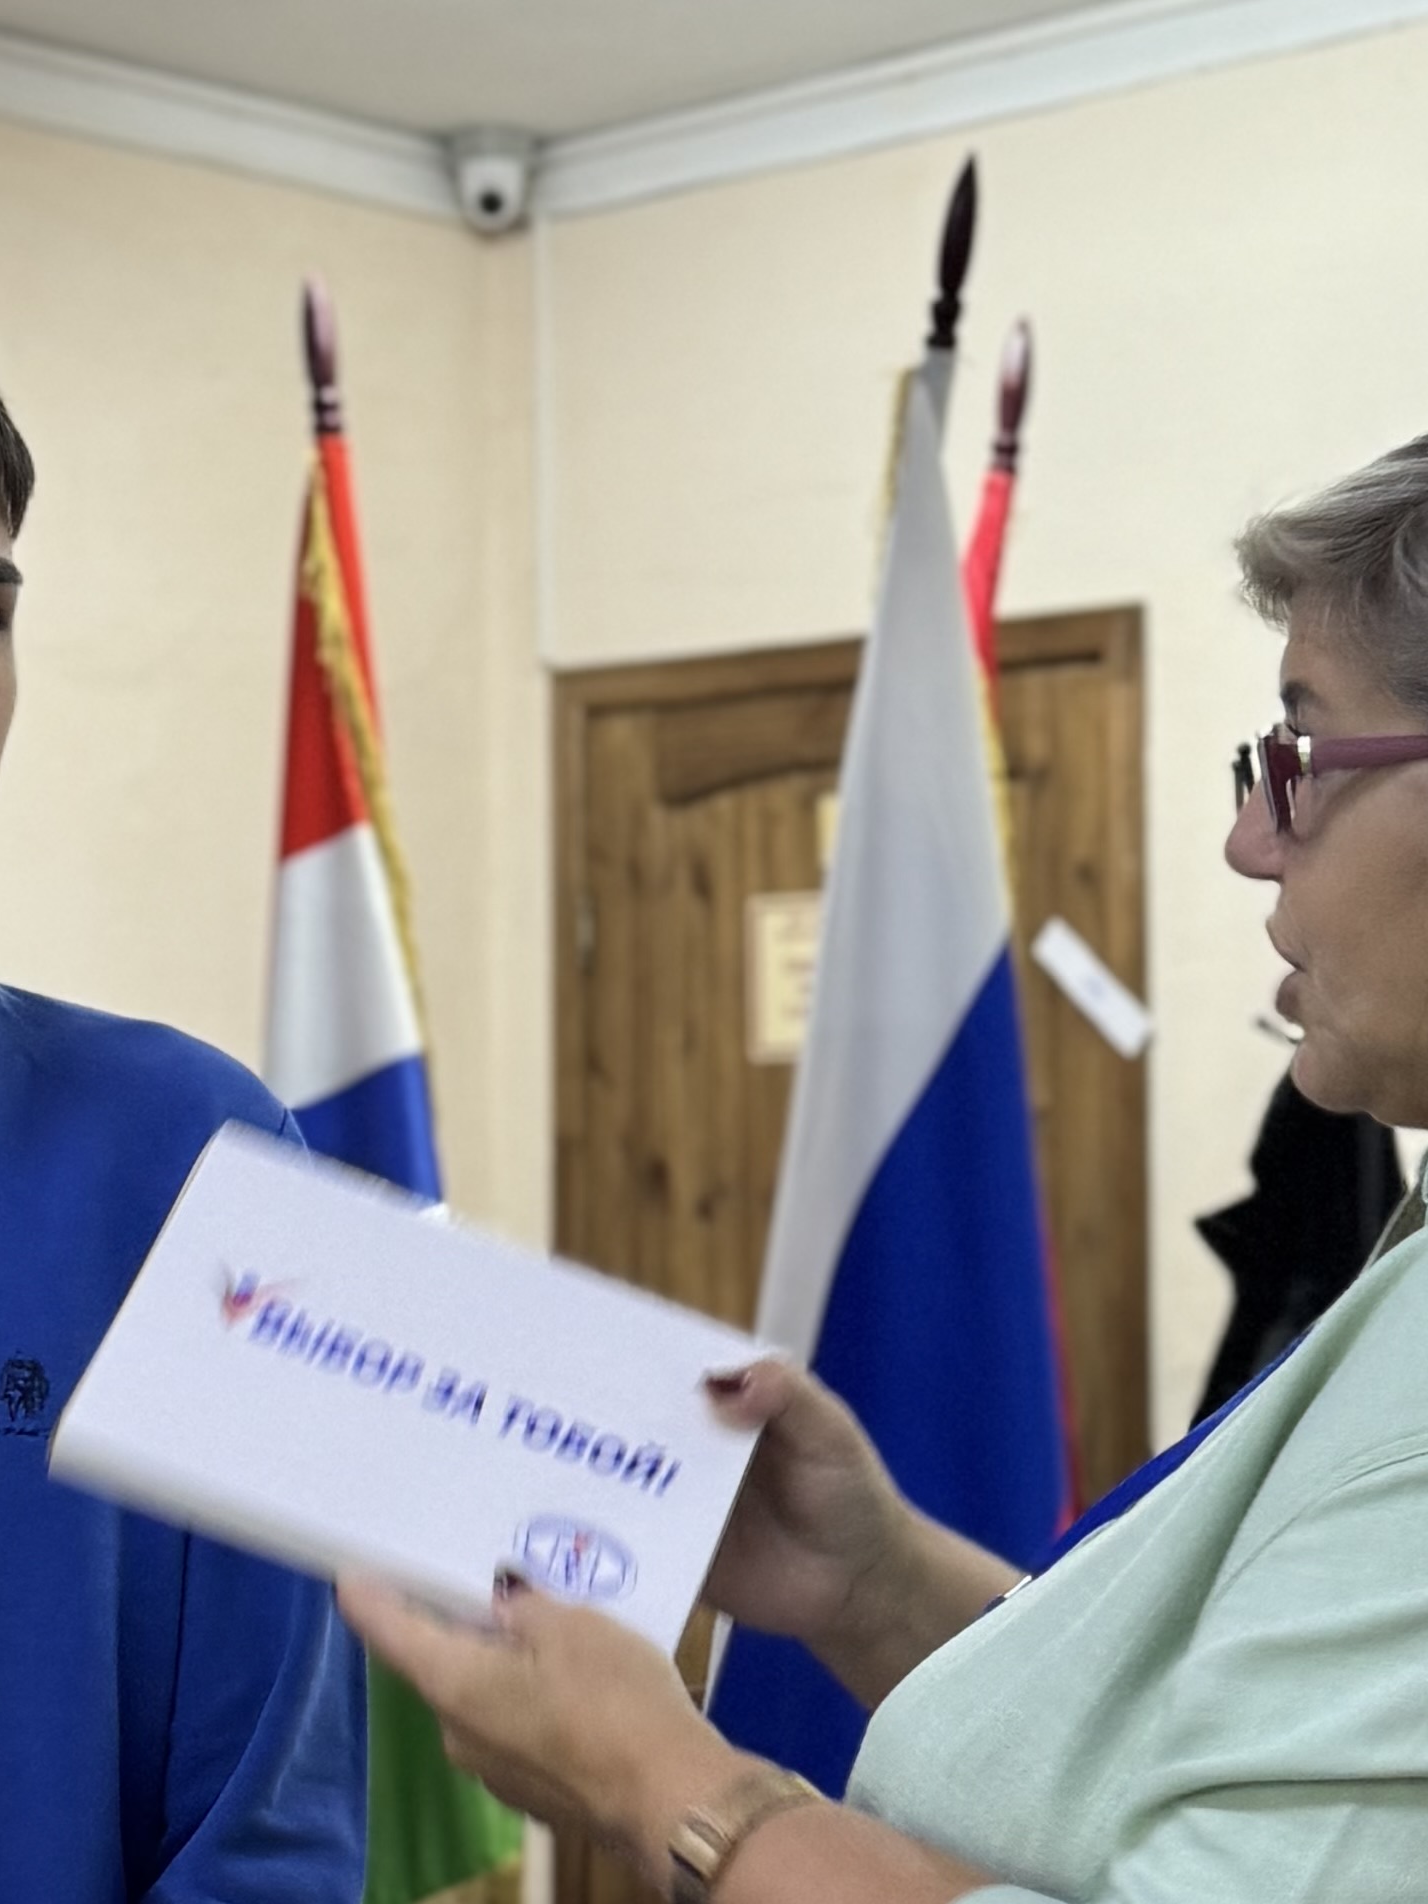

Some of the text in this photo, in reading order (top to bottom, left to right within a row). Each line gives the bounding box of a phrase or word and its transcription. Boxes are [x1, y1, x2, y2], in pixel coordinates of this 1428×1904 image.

[247, 1296, 683, 1499] ВЫБОР ЗА ТОБОЙ!
